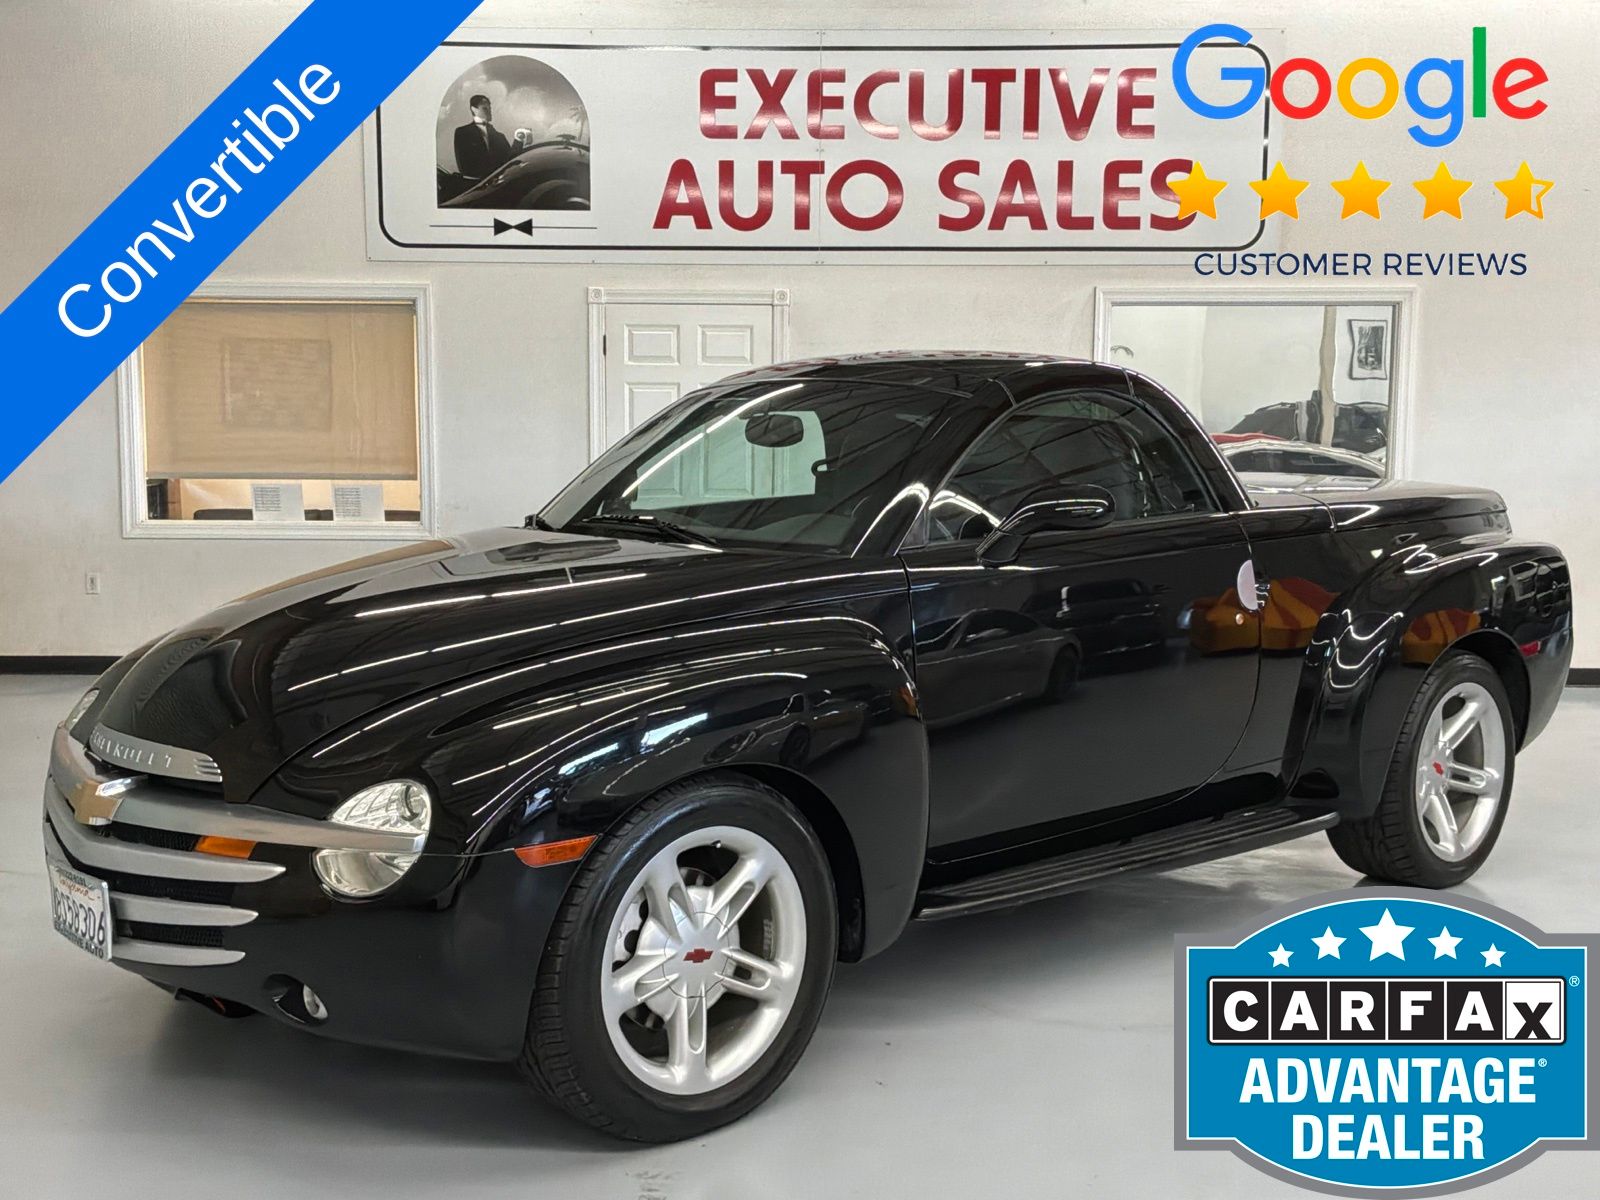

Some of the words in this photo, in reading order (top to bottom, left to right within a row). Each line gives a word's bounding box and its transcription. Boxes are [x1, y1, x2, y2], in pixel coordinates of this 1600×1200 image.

[699, 67, 1157, 141] EXECUTIVE
[652, 158, 905, 232] AUTO
[937, 158, 1198, 233] SALES
